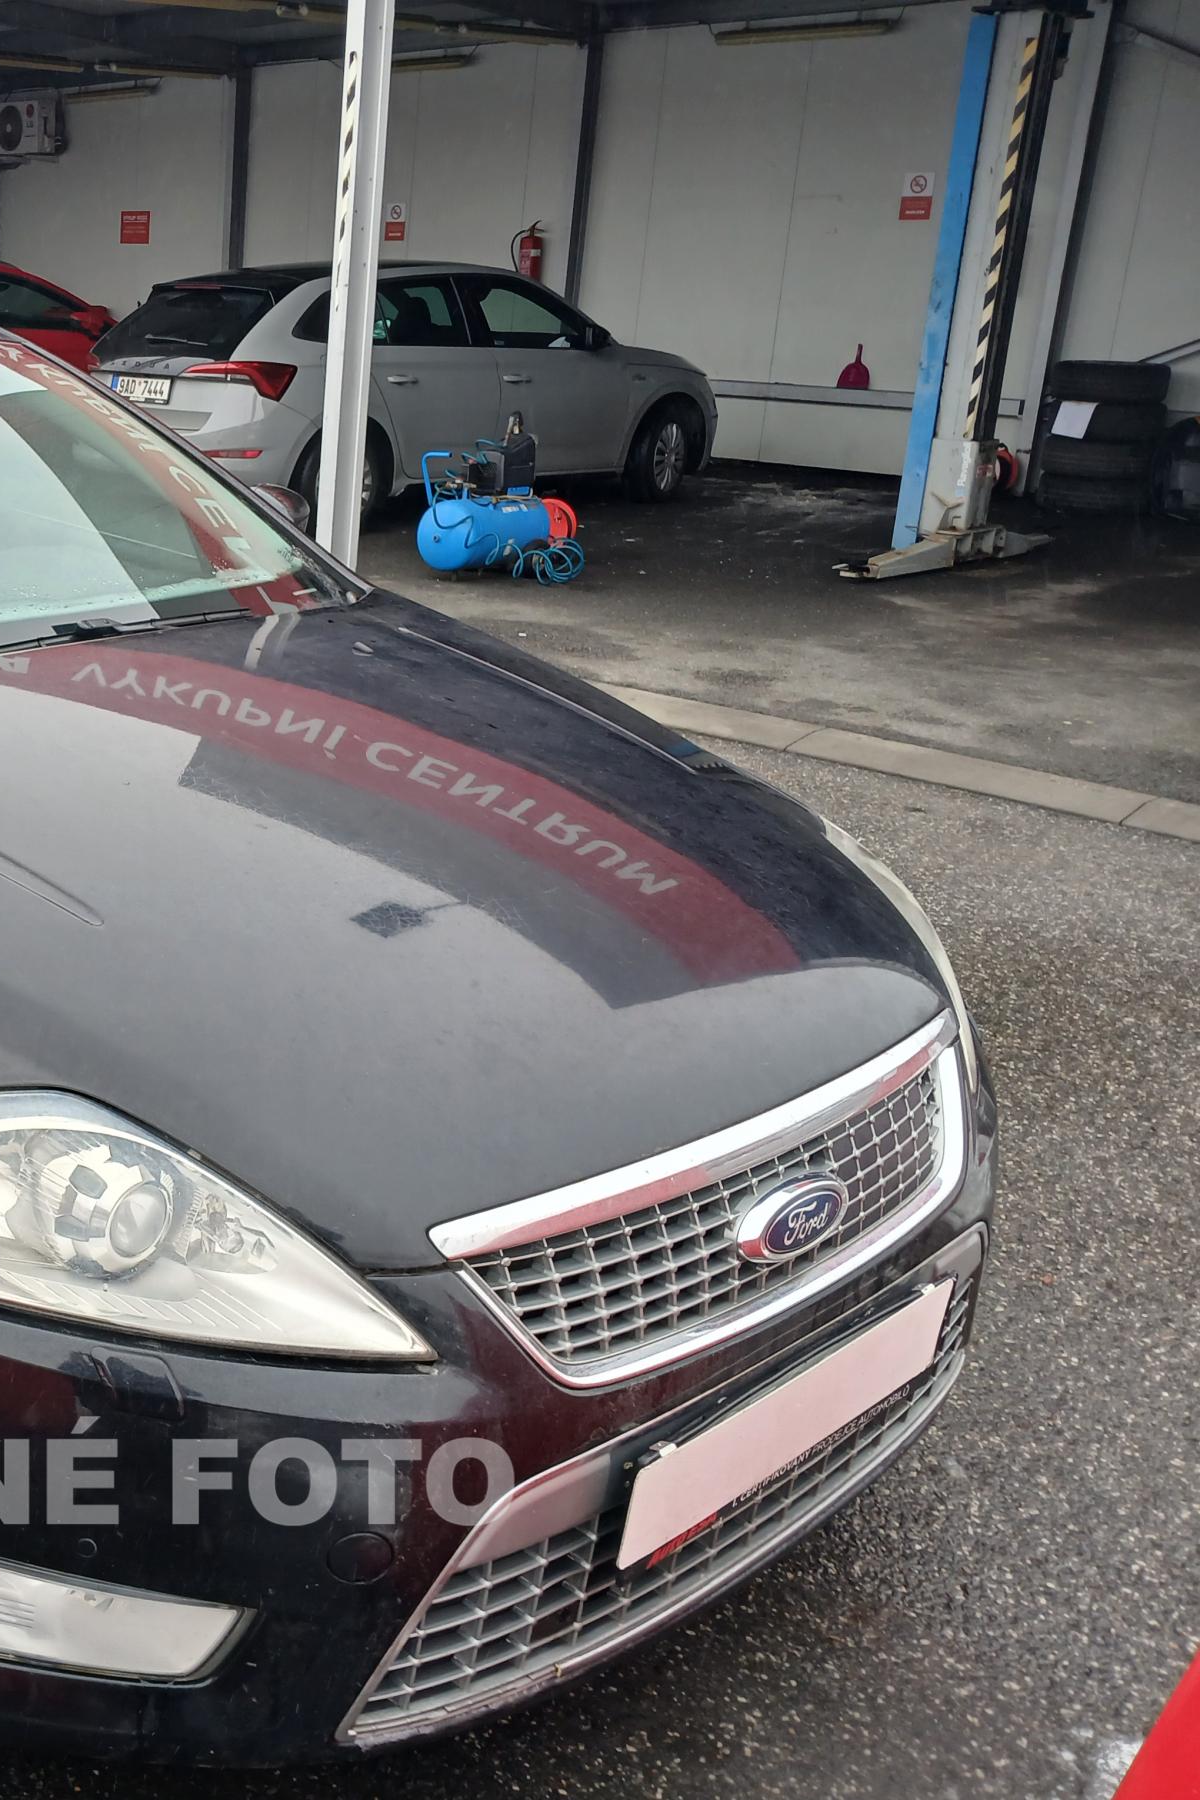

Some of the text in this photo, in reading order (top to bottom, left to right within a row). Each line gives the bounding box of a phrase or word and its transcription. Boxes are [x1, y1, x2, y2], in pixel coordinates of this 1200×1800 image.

[118, 378, 165, 397] 9AD 7444
[784, 1200, 830, 1246] Ford
